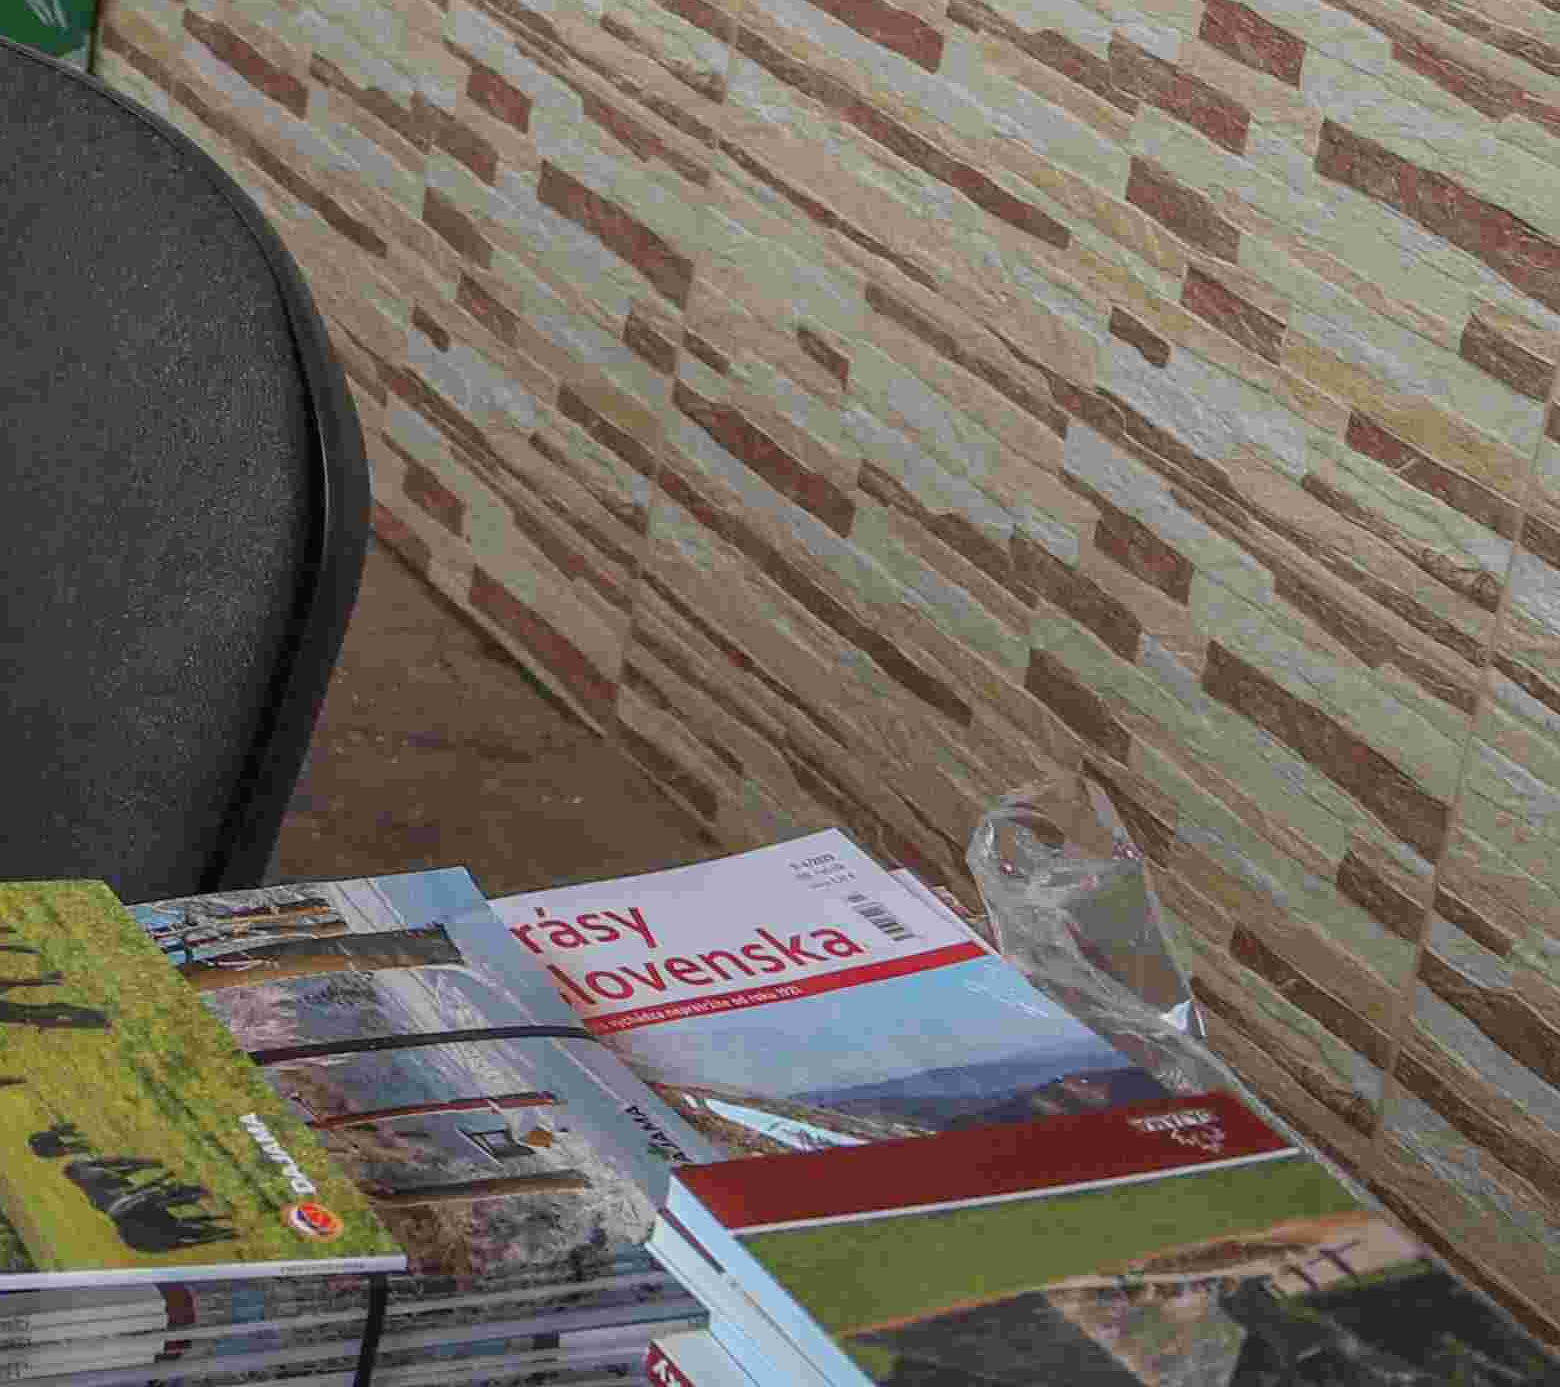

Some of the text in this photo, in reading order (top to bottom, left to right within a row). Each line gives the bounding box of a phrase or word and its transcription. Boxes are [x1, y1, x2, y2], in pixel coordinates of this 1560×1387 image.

[511, 905, 660, 956] rásy
[545, 925, 866, 1007] lovenska
[240, 1111, 317, 1196] DAJAMA
